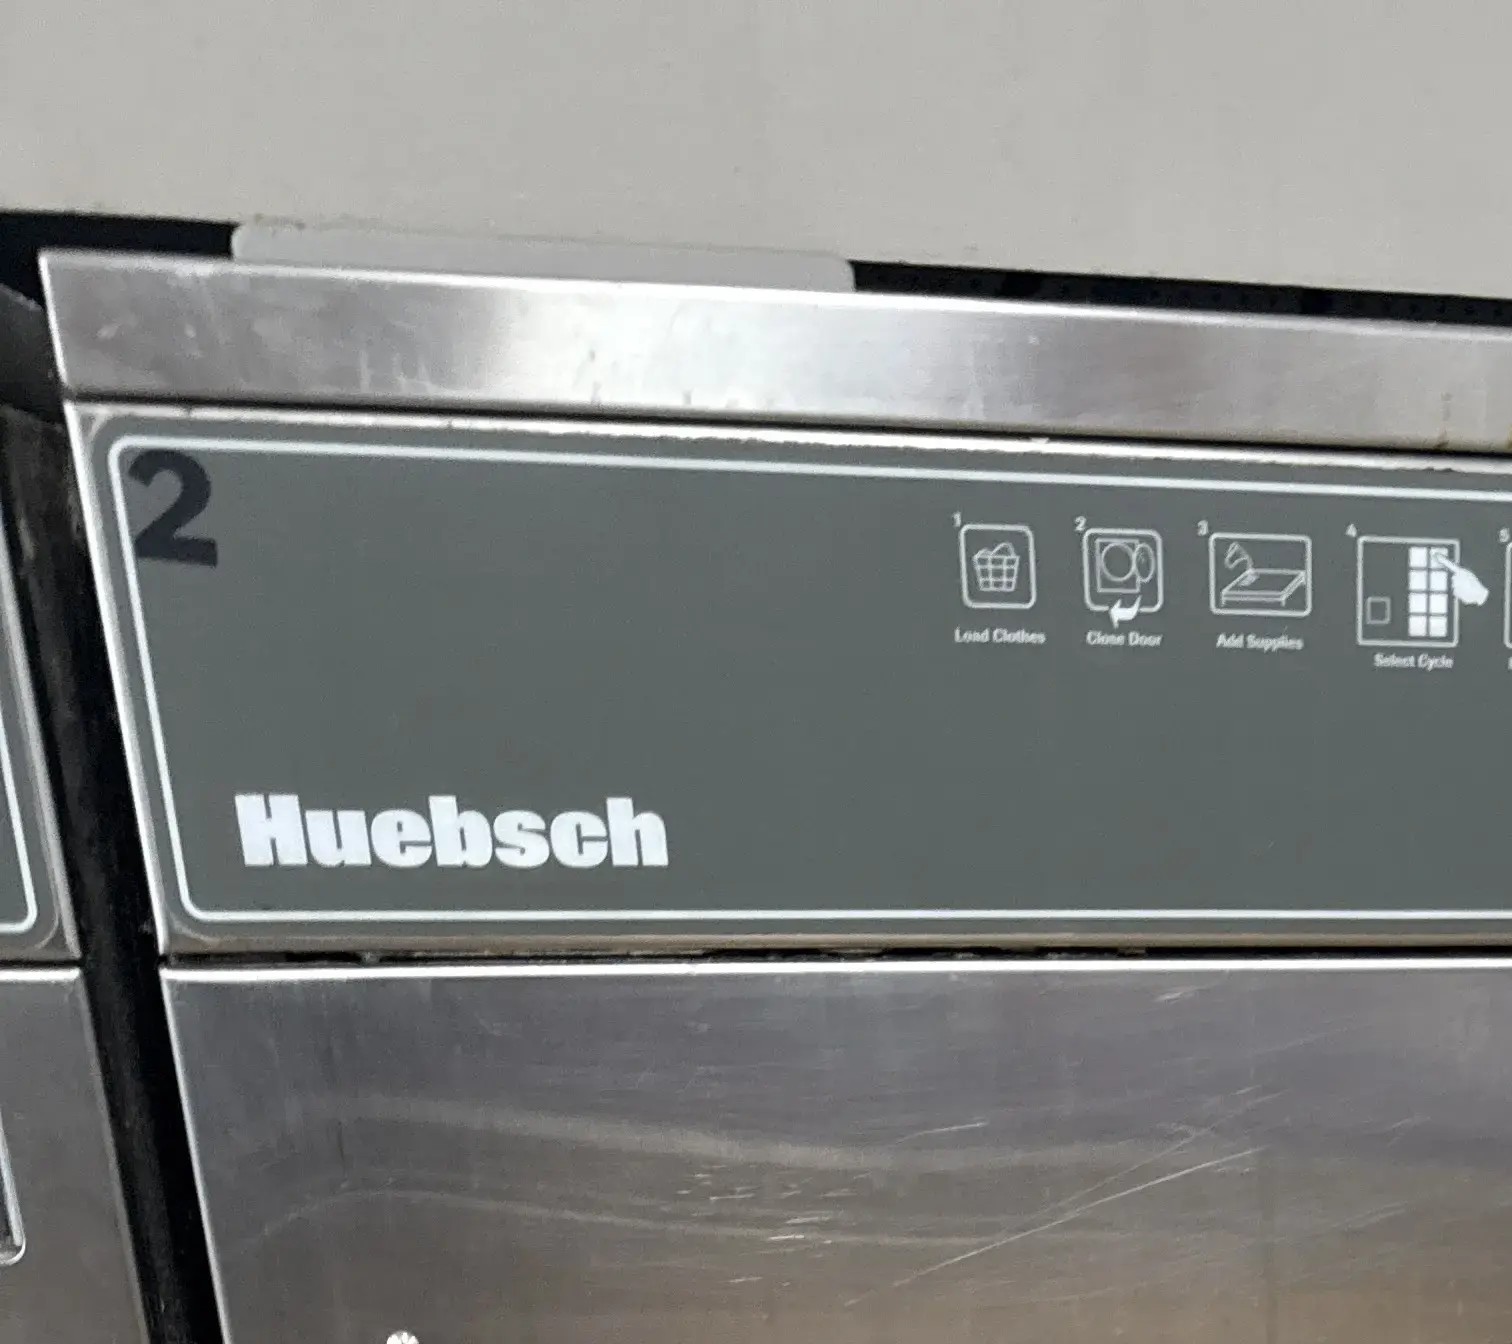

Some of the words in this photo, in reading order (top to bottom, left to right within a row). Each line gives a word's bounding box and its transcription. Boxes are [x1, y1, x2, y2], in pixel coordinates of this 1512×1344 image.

[128, 449, 218, 567] 2
[952, 512, 962, 527] 1
[1074, 515, 1087, 532] 2
[1197, 520, 1209, 536] 3
[1345, 523, 1357, 538] 4
[1499, 527, 1510, 543] 5
[954, 627, 989, 644] Load
[992, 628, 1046, 645] Clothes
[1086, 630, 1124, 646] Close
[1128, 631, 1163, 647] Door
[1216, 632, 1244, 649] Add
[1247, 634, 1304, 654] Supplies
[1373, 653, 1415, 668] Select
[1417, 654, 1454, 672] Cycle
[234, 793, 669, 867] Huebsch
